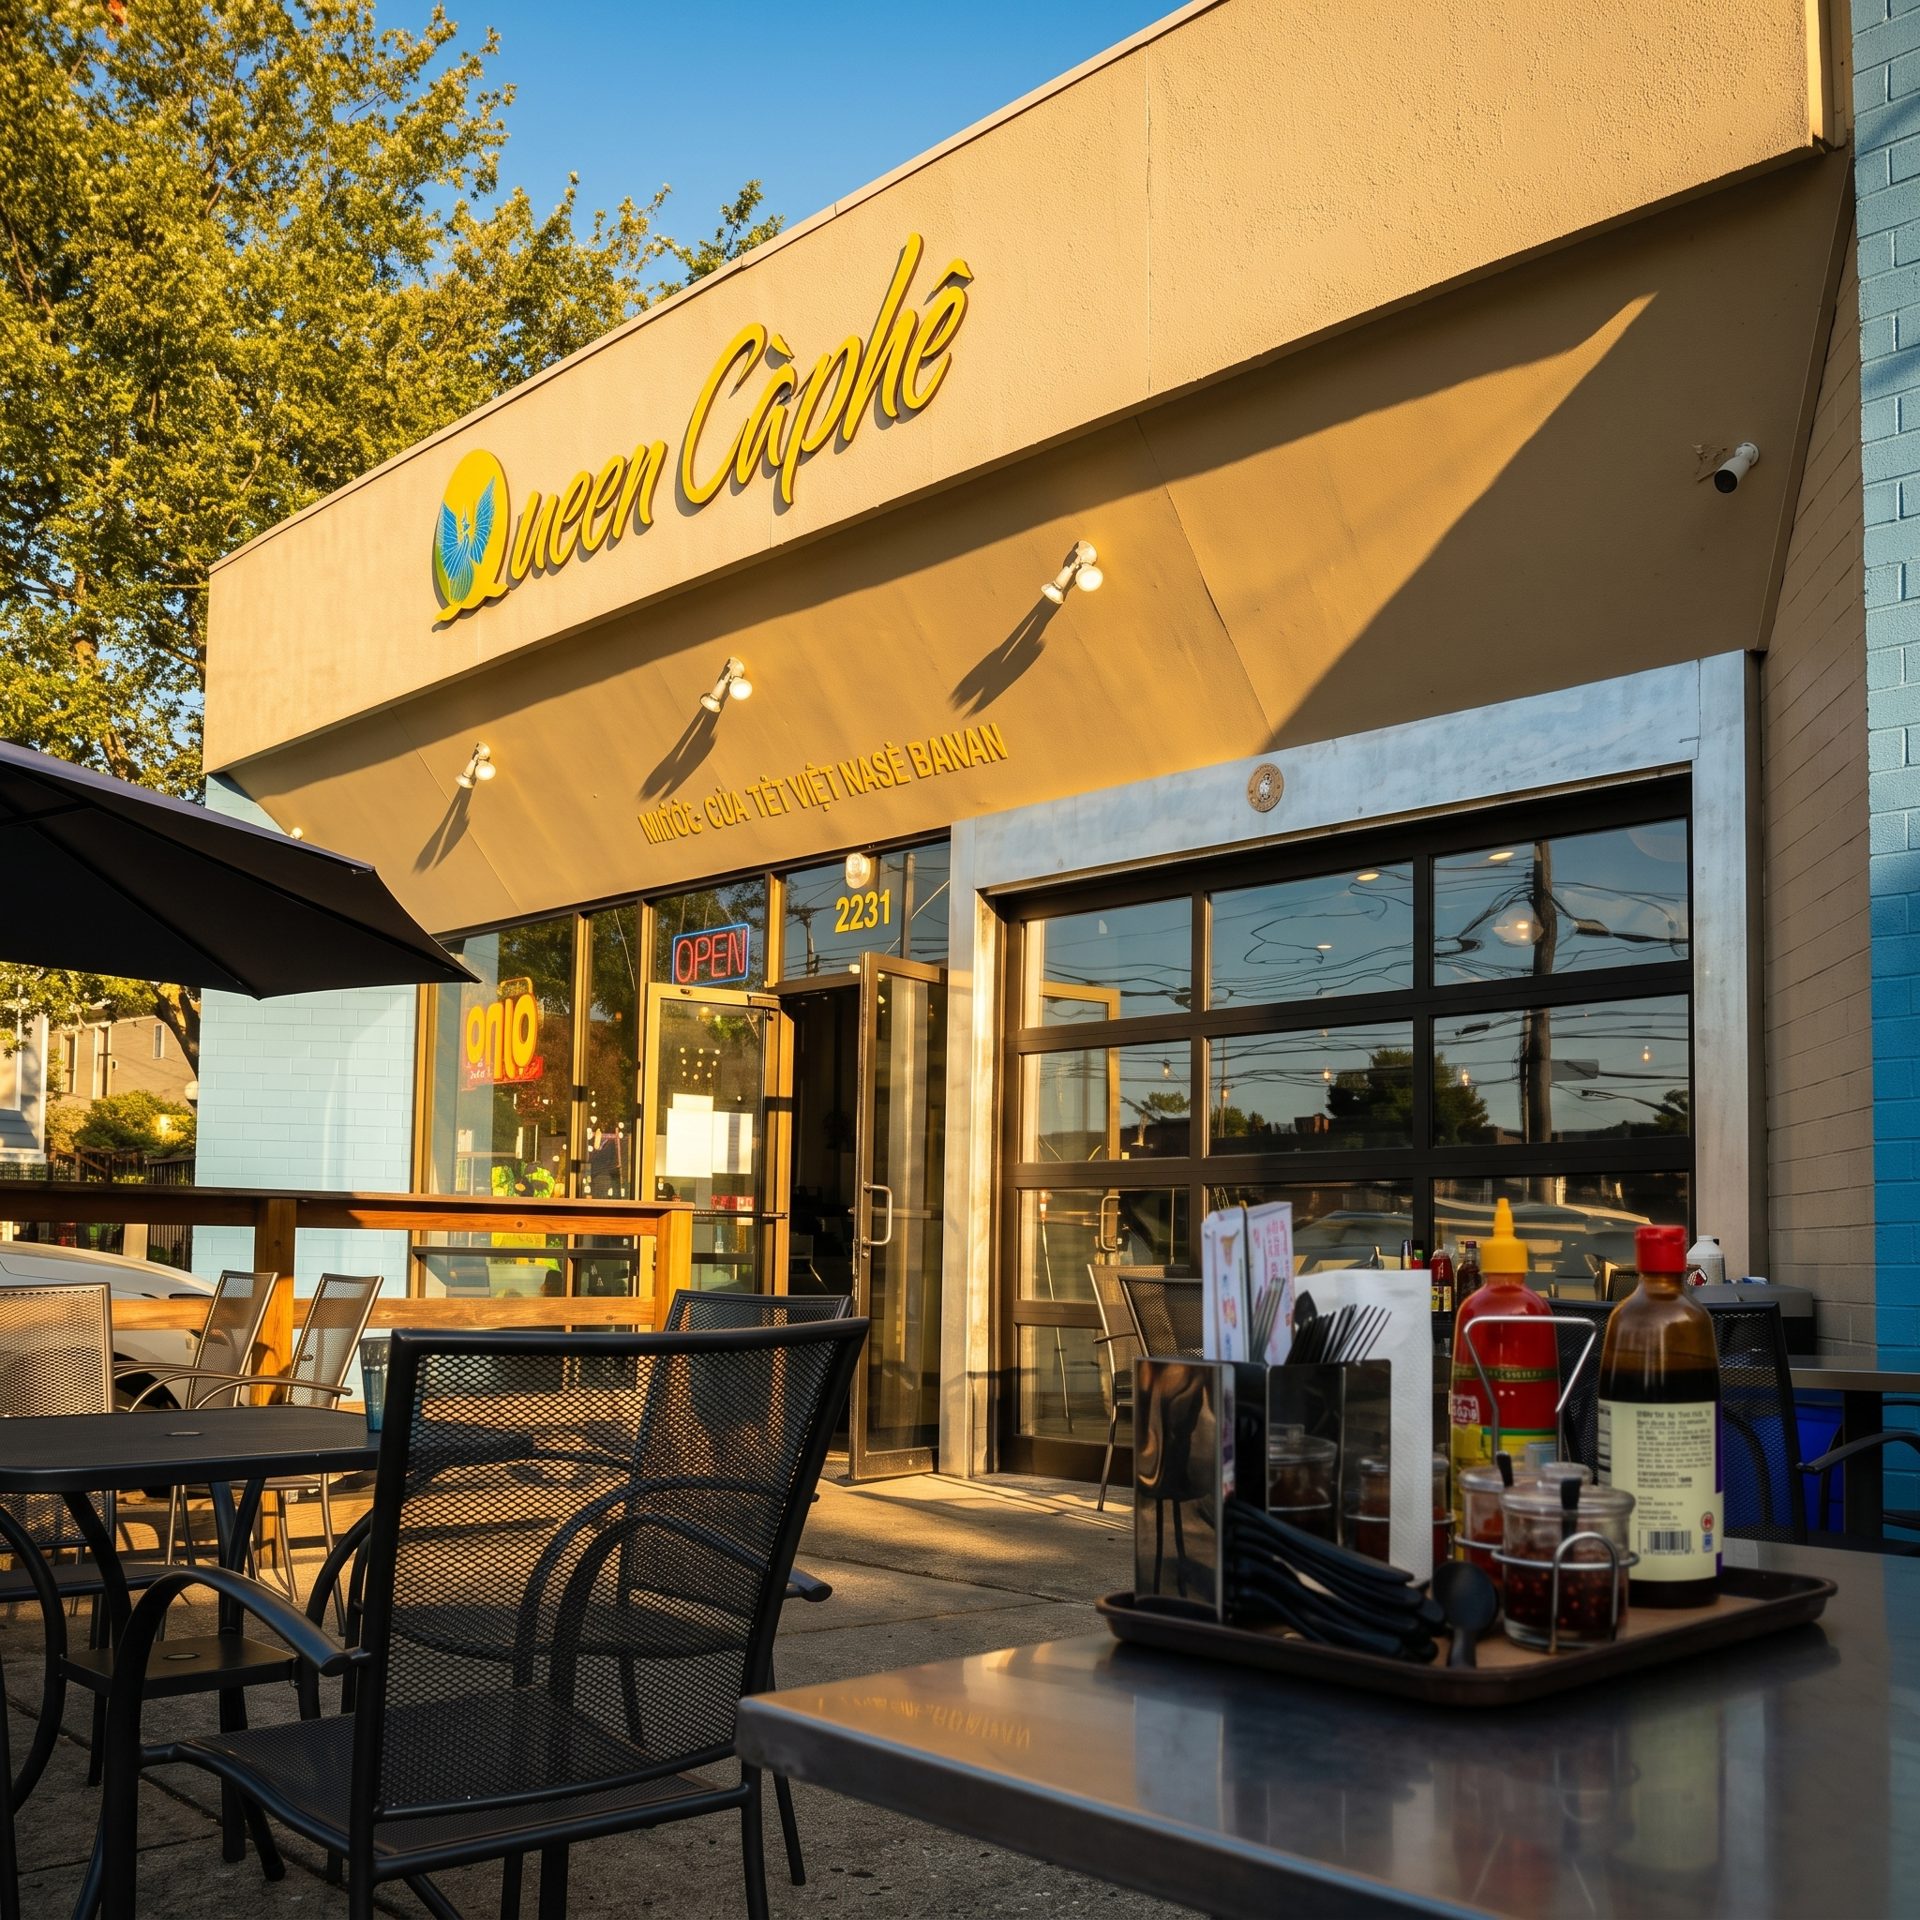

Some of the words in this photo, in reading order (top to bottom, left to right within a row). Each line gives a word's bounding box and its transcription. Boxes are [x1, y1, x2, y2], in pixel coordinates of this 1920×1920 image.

[434, 440, 668, 622] Queen
[682, 232, 974, 504] Càphê
[905, 722, 1009, 779] BANAN
[834, 889, 891, 933] 2231
[675, 929, 747, 984] OPEN
